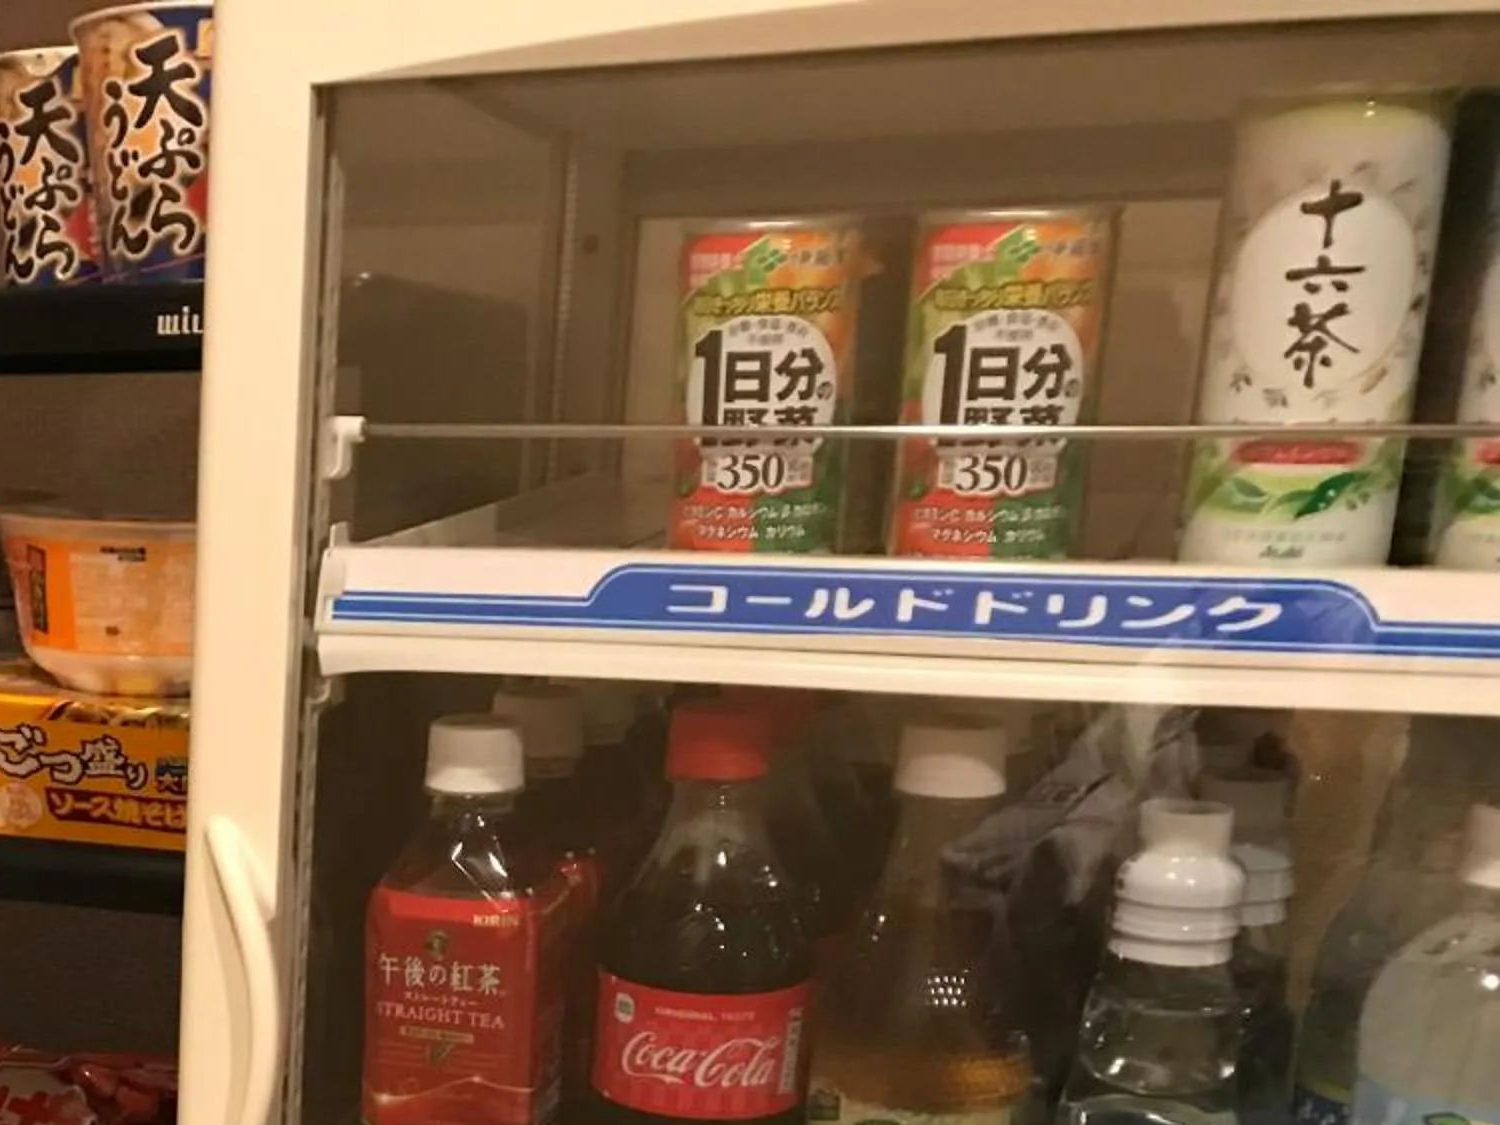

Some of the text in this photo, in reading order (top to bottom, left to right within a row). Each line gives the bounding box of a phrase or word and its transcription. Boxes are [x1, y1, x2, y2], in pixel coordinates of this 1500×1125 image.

[102, 81, 148, 256] うどん
[129, 36, 203, 252] 天ぷら
[14, 82, 81, 278] 天ぷら
[1283, 178, 1368, 390] 十六茶
[717, 454, 785, 490] 350
[955, 454, 1028, 491] 350
[667, 583, 1284, 635] コールドドリンク
[378, 952, 501, 996] 午後の紅茶
[467, 1012, 506, 1030] TEA
[621, 1030, 780, 1089] Coca-Cola
